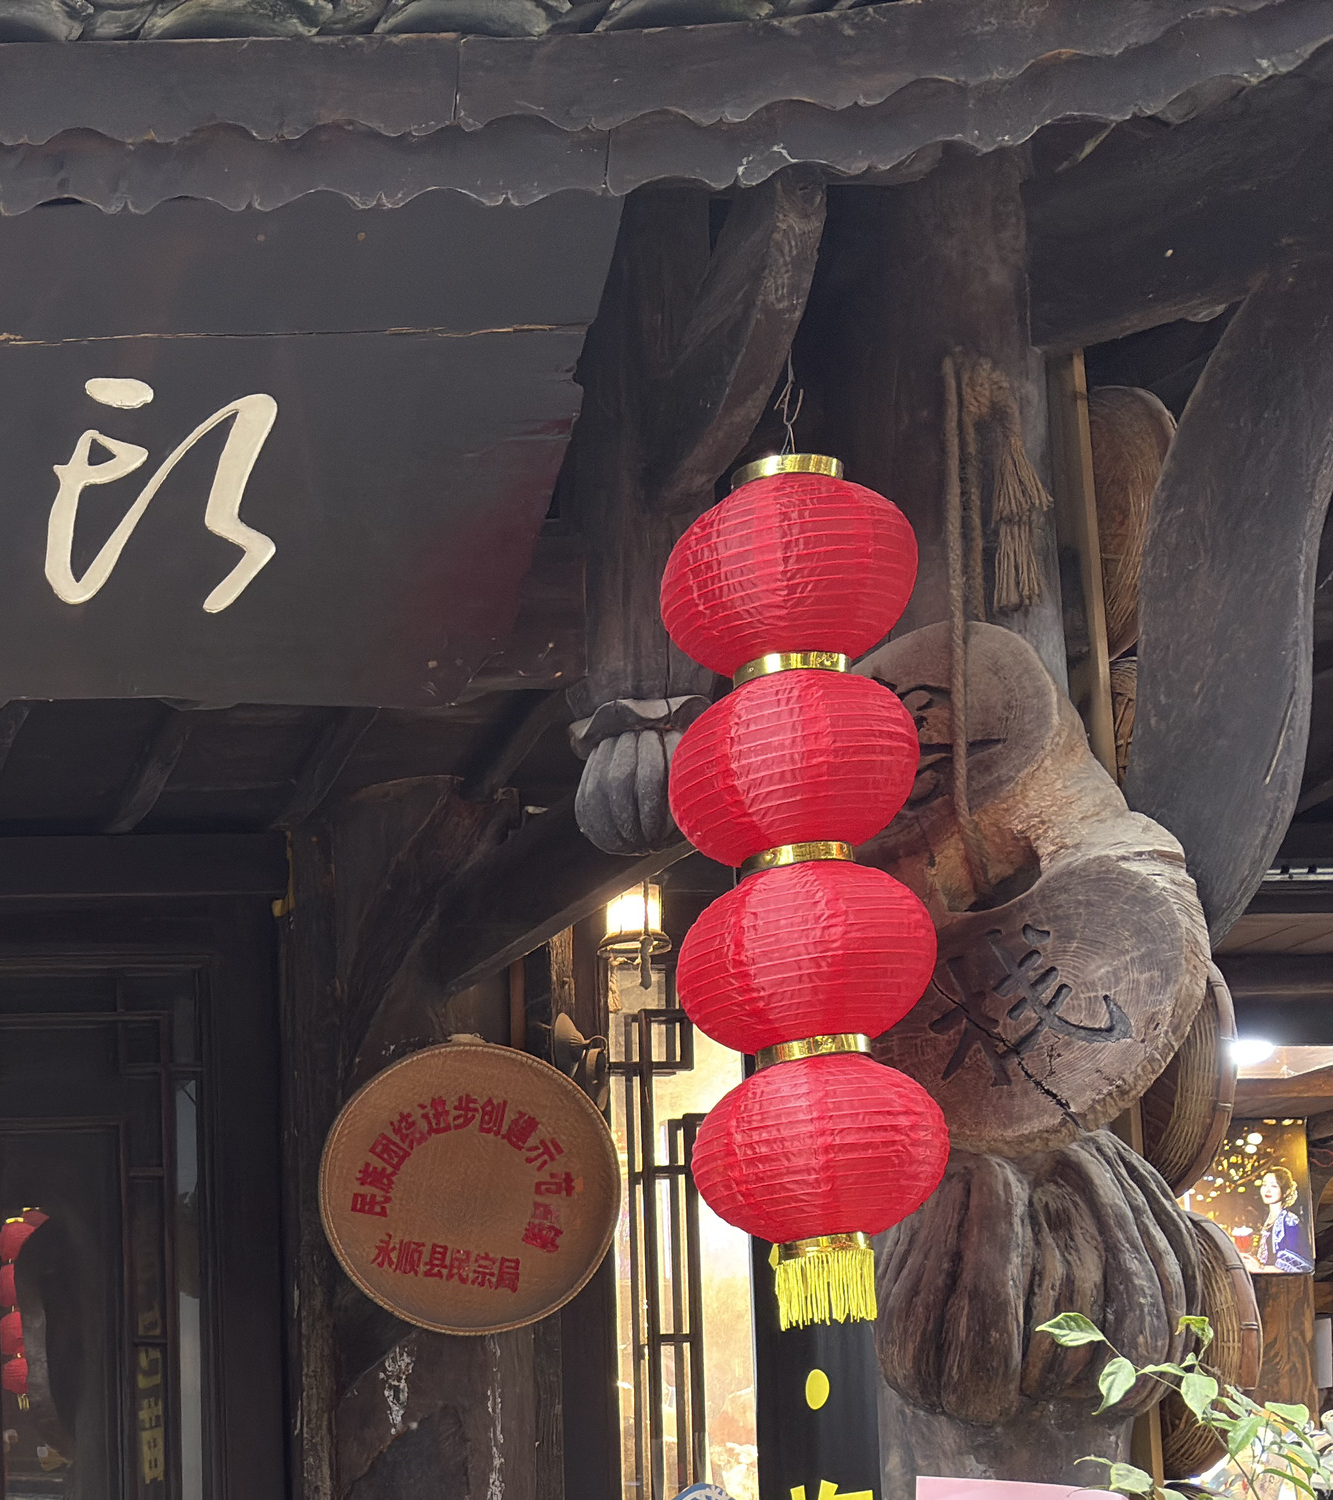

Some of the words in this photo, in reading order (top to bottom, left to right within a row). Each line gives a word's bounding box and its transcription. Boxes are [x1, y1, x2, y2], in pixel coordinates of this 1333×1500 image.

[370, 1232, 521, 1293] 永顺县民宗局
